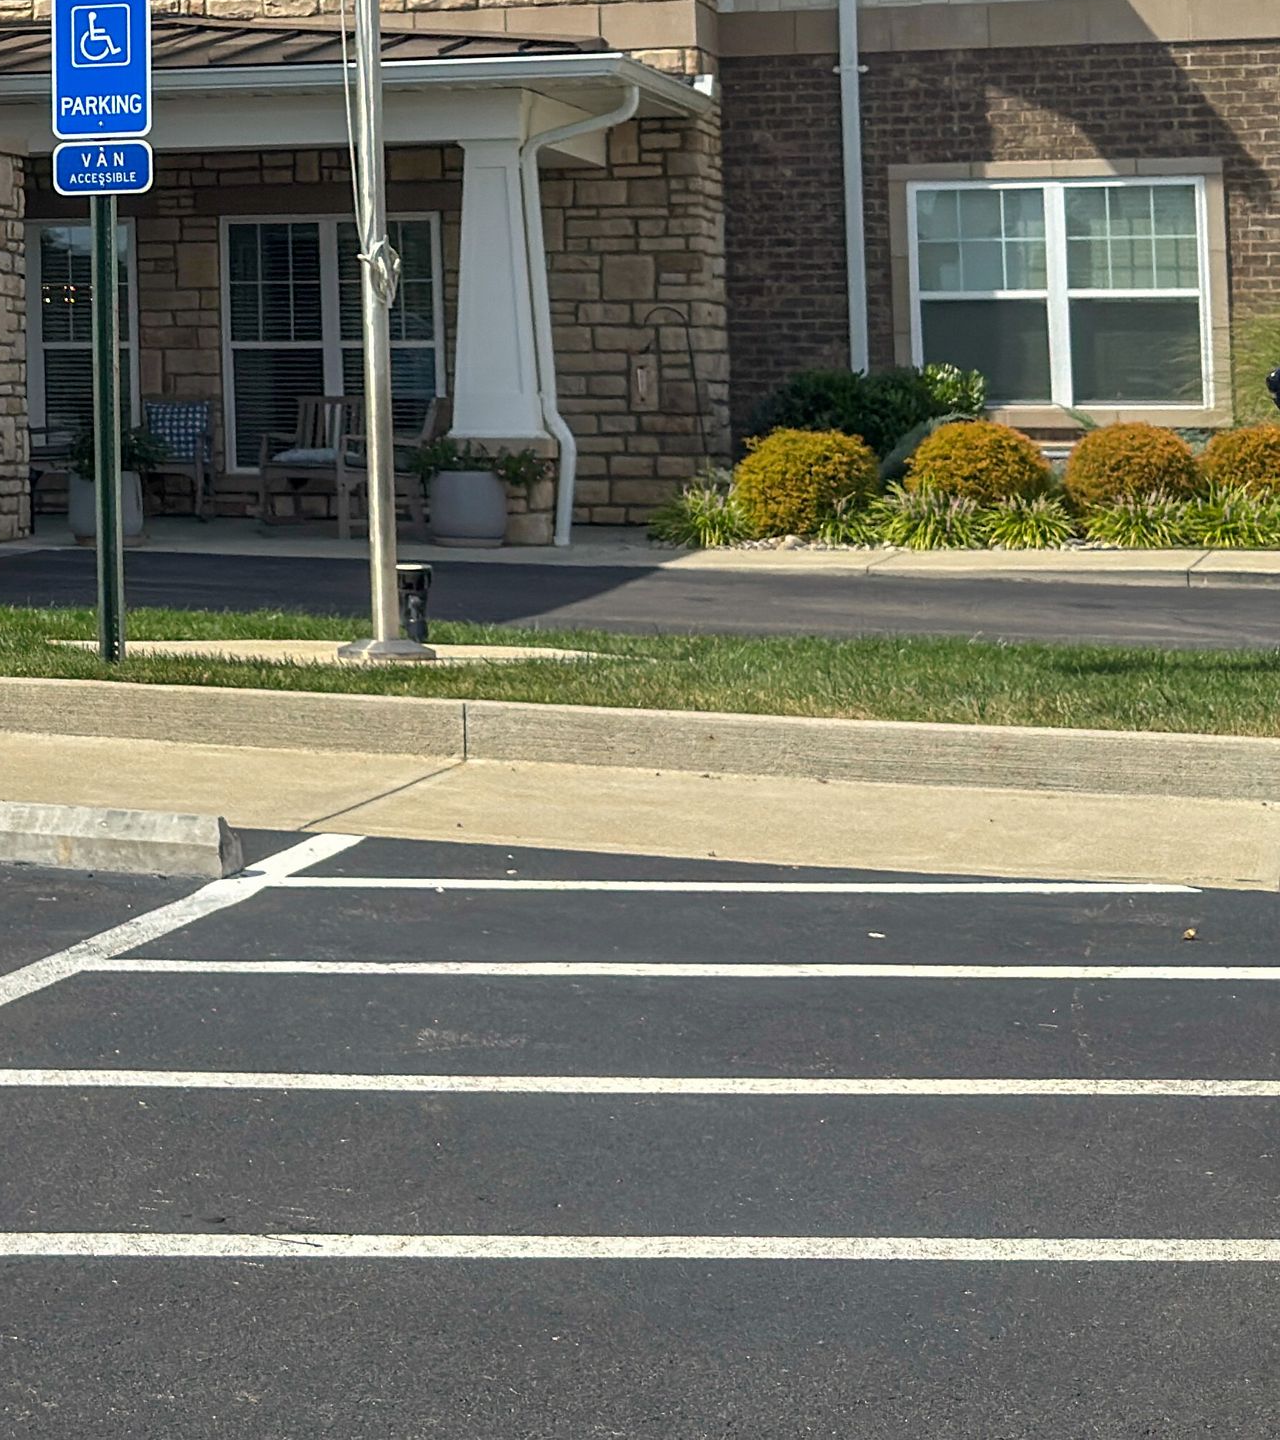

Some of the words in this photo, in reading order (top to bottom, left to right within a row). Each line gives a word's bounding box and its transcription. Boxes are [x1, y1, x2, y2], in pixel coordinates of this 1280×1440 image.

[61, 93, 142, 117] PARKING
[81, 151, 124, 168] VAN
[69, 171, 137, 185] ACCESSIBLE
